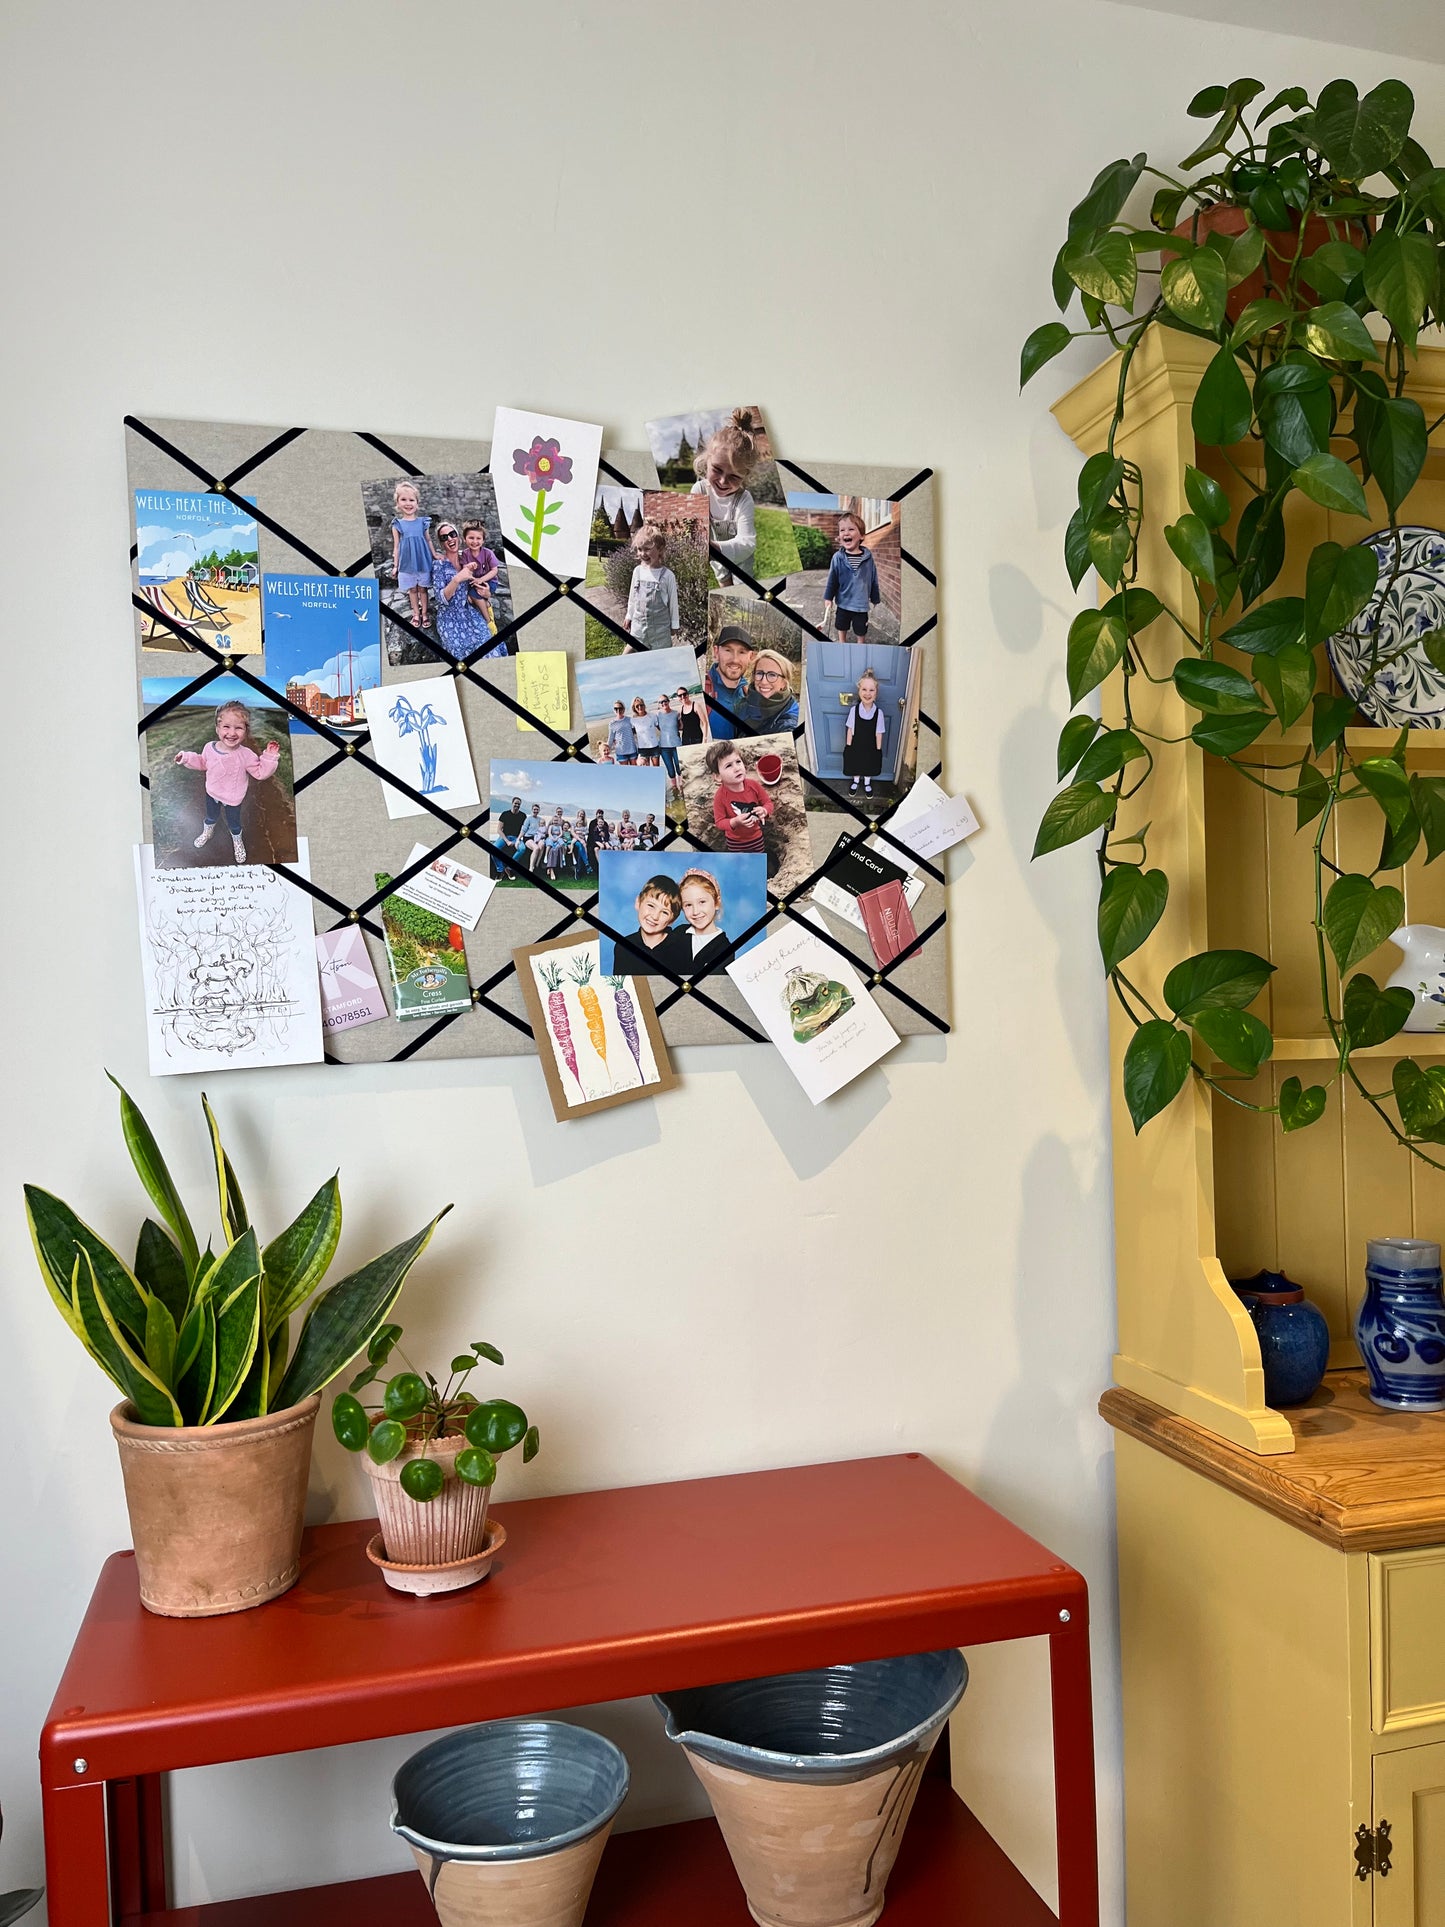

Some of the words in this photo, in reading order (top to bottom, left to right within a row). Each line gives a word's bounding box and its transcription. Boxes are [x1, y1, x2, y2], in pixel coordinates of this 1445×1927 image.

[135, 496, 247, 516] WELLS-NEXT-THE-SE
[266, 581, 372, 600] WELLS-NEXT-THE-SEA
[302, 601, 338, 609] NORFOLK
[838, 841, 866, 862] Rund
[864, 858, 884, 874] Card
[746, 958, 781, 982] Speedy
[422, 990, 443, 998] Cress
